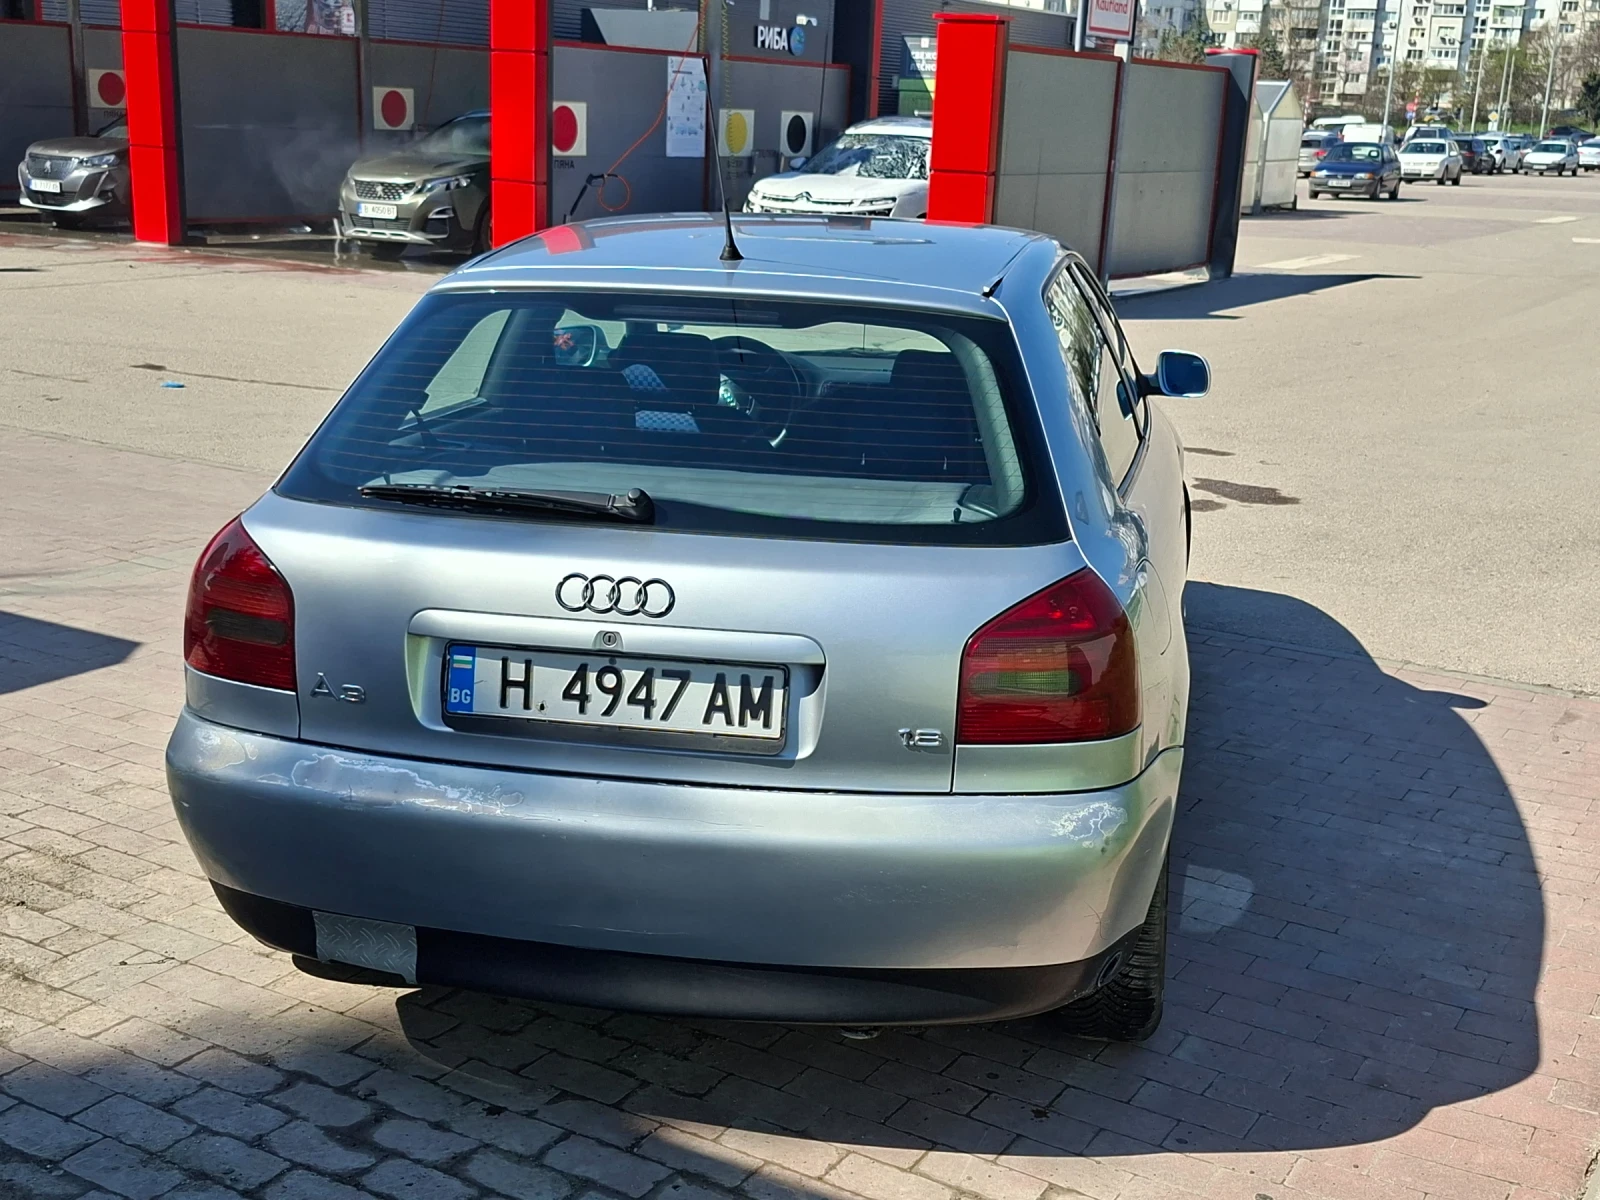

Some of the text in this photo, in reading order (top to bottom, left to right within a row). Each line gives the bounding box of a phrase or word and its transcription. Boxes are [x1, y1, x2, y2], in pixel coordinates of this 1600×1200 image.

[757, 25, 788, 51] РИБА
[553, 160, 575, 169] ПЯНА
[310, 671, 366, 703] A3
[450, 688, 472, 704] BG
[499, 656, 774, 729] H 4947 AM
